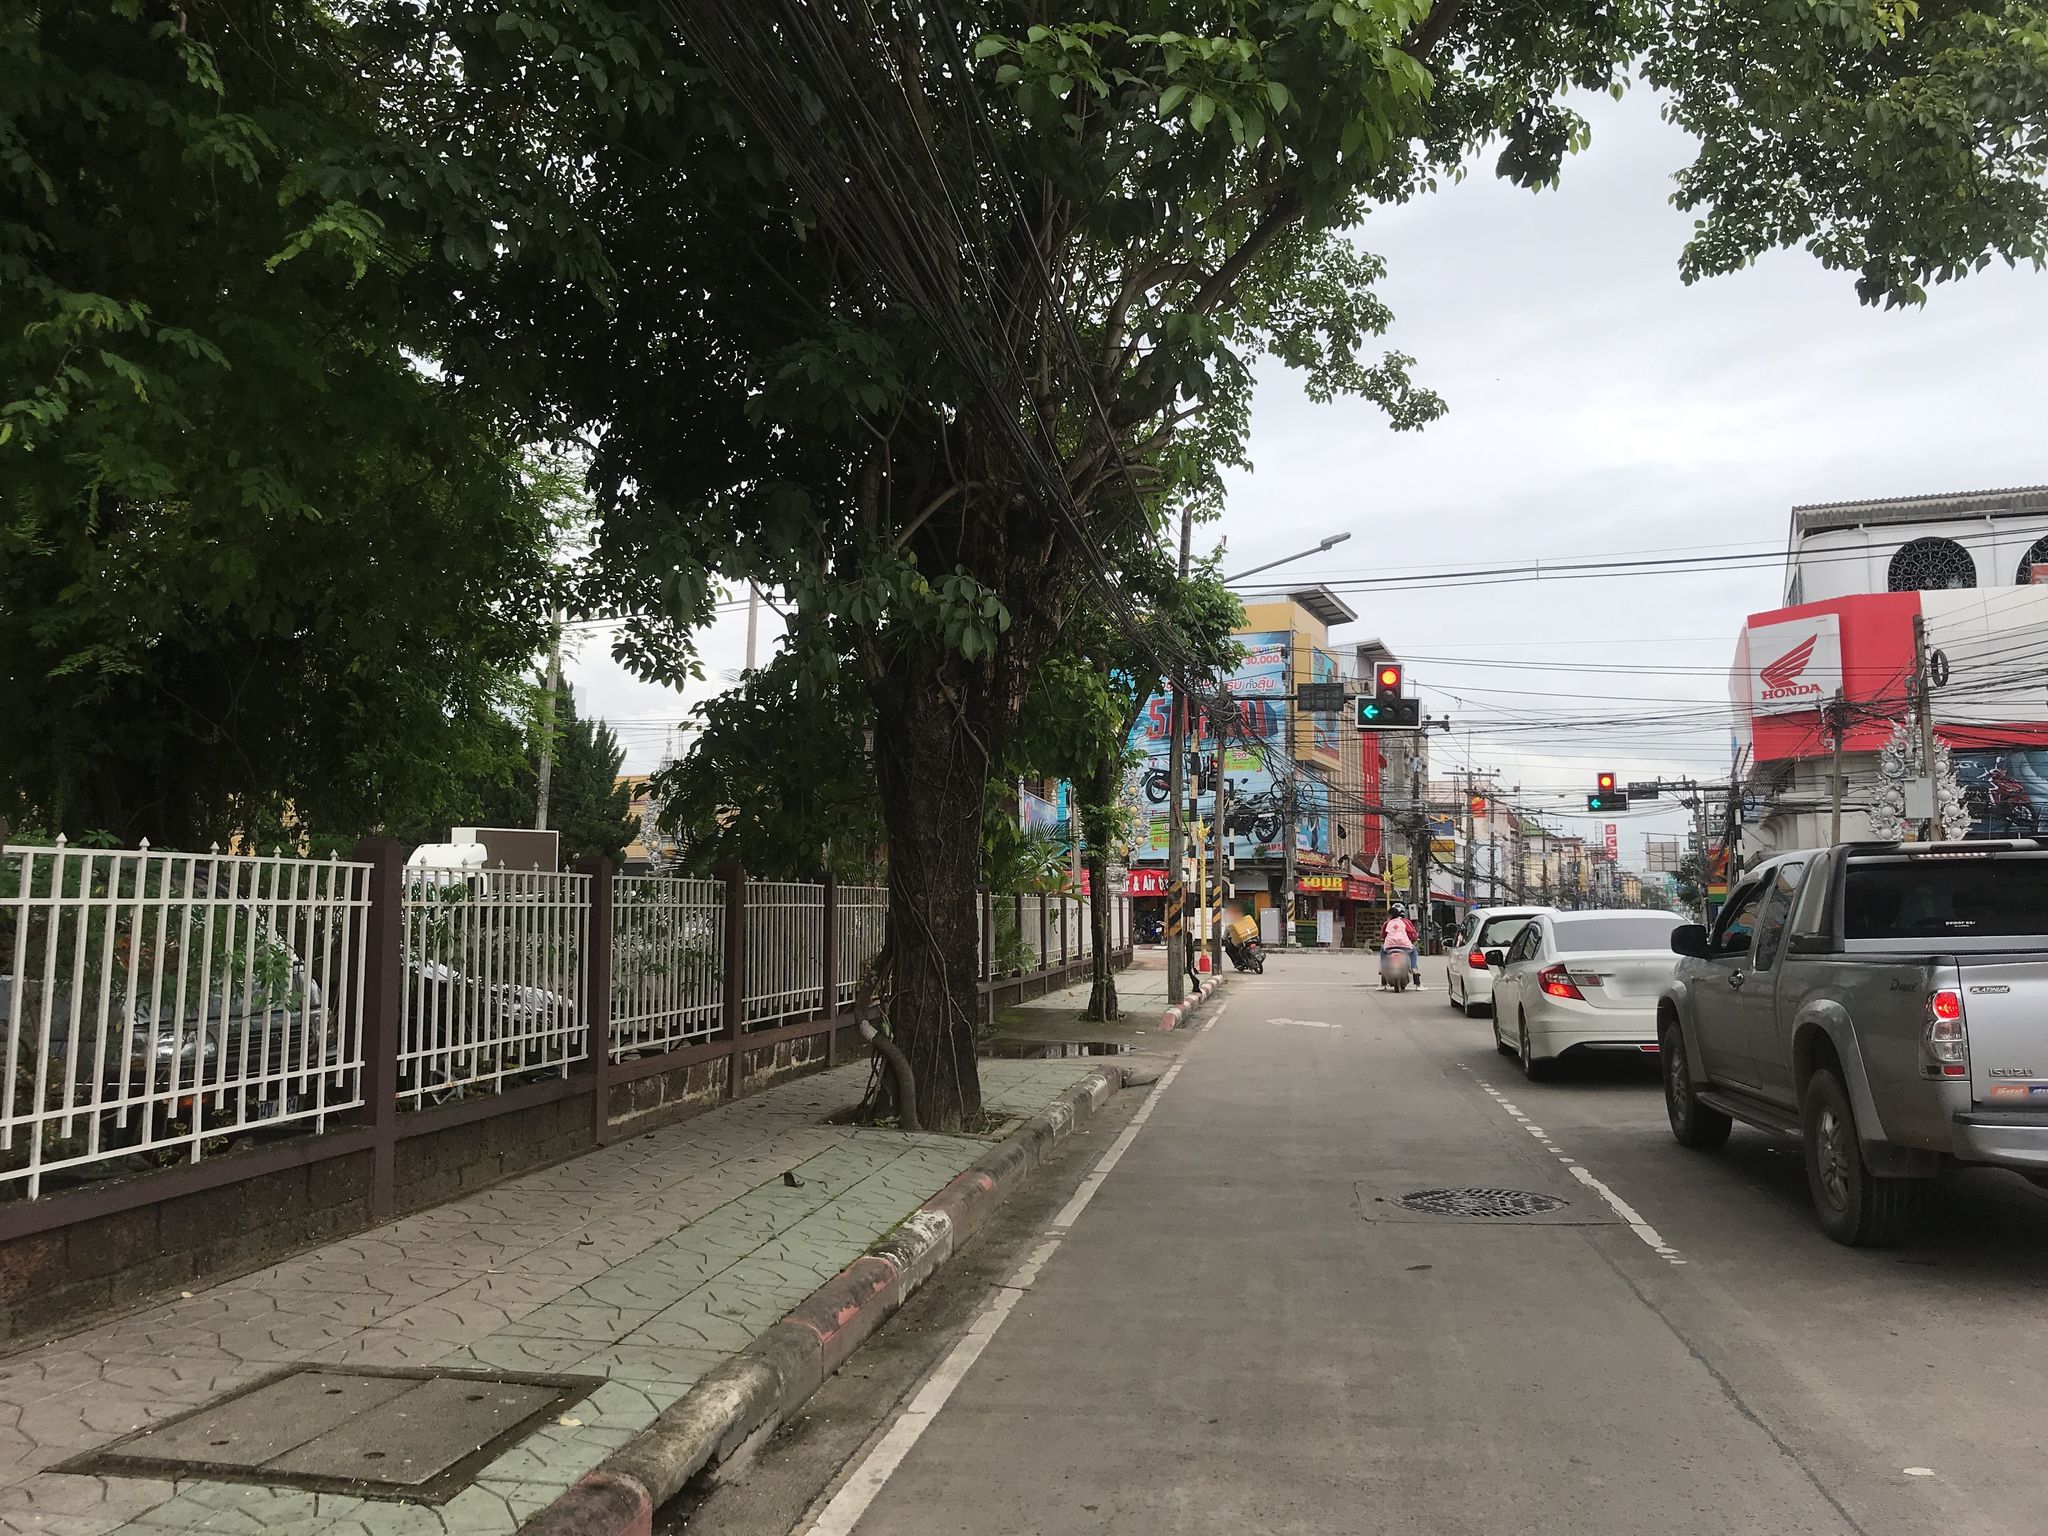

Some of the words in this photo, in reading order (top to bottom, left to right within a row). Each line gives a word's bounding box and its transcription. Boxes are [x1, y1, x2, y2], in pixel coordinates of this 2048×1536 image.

[1761, 683, 1823, 700] HONDA
[1132, 875, 1140, 892] &
[1142, 873, 1155, 891] Air
[1301, 877, 1343, 888] TOUR
[1988, 1067, 2033, 1078] ISUZU
